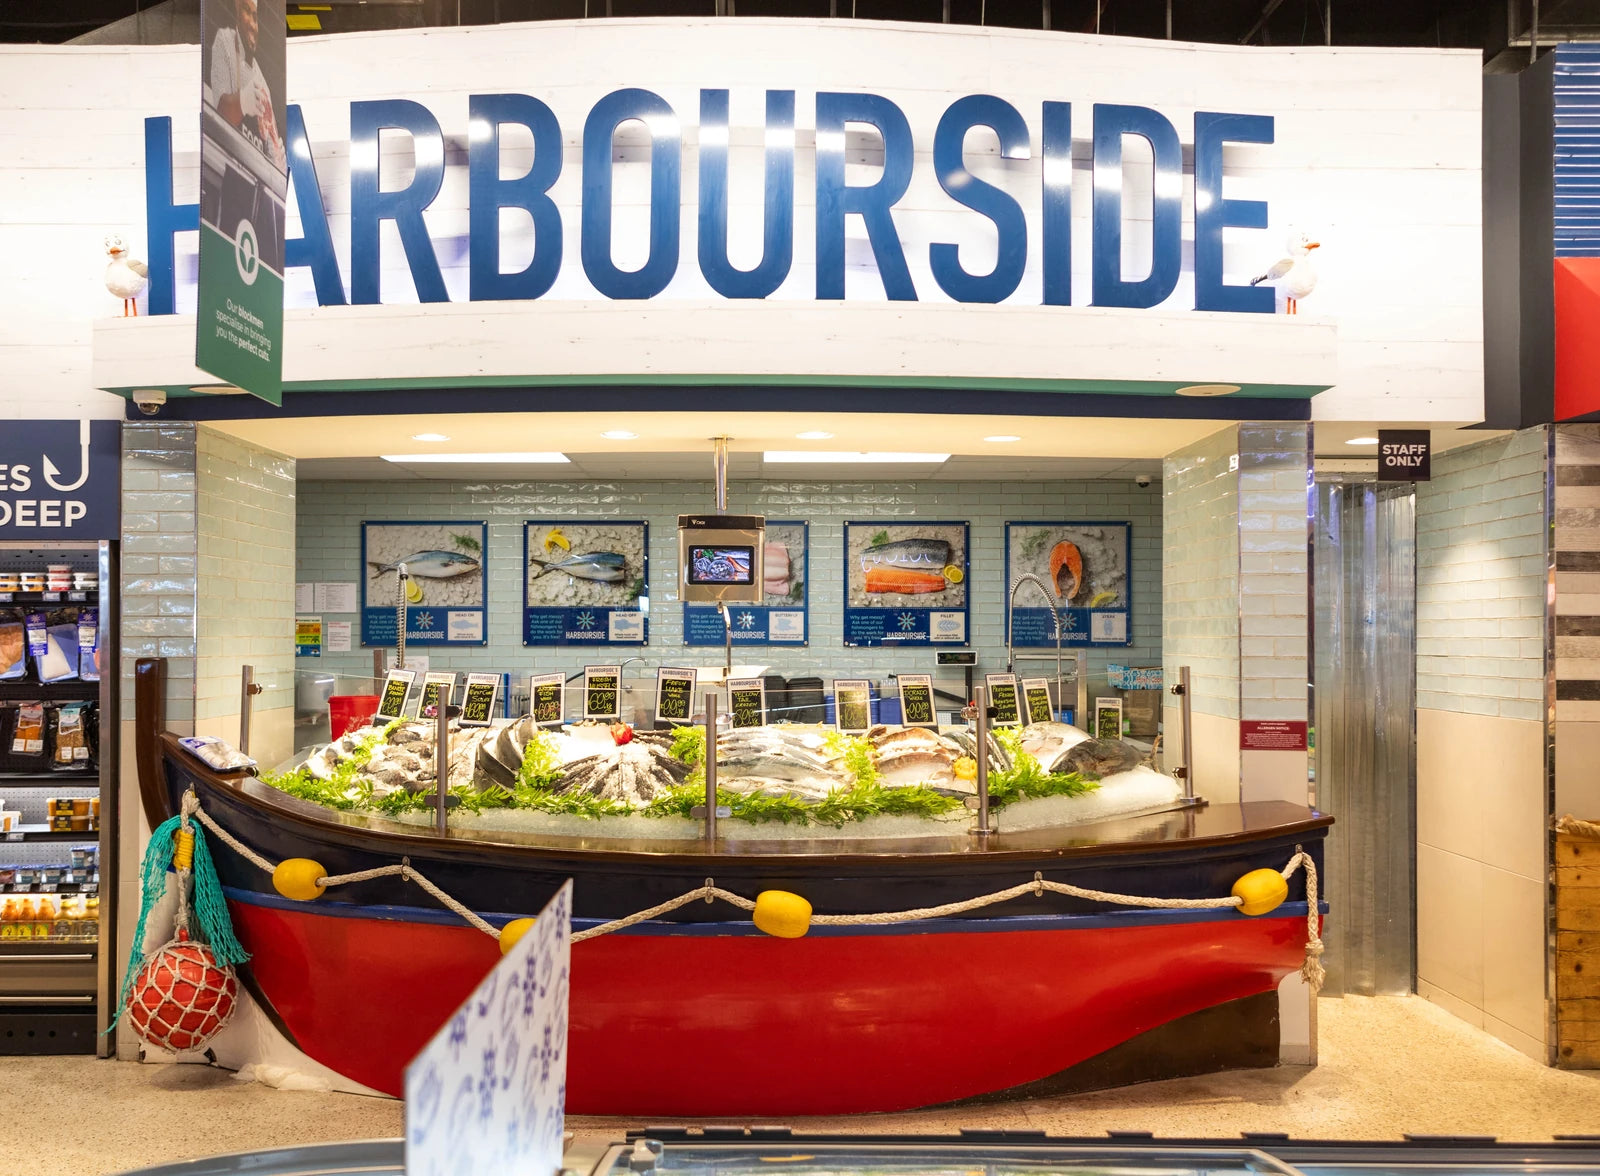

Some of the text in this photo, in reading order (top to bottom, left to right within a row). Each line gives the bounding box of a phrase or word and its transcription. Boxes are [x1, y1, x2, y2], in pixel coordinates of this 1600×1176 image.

[144, 86, 1276, 315] HARBOURSIDE
[226, 298, 264, 330] Our blockmen
[216, 310, 272, 351] specialise in bringing
[216, 326, 228, 339] you
[228, 330, 238, 344] the
[238, 338, 258, 356] perfect
[1382, 444, 1426, 455] STAFF
[1386, 456, 1424, 466] ONLY
[887, 632, 927, 640] HARBOURSIDE
